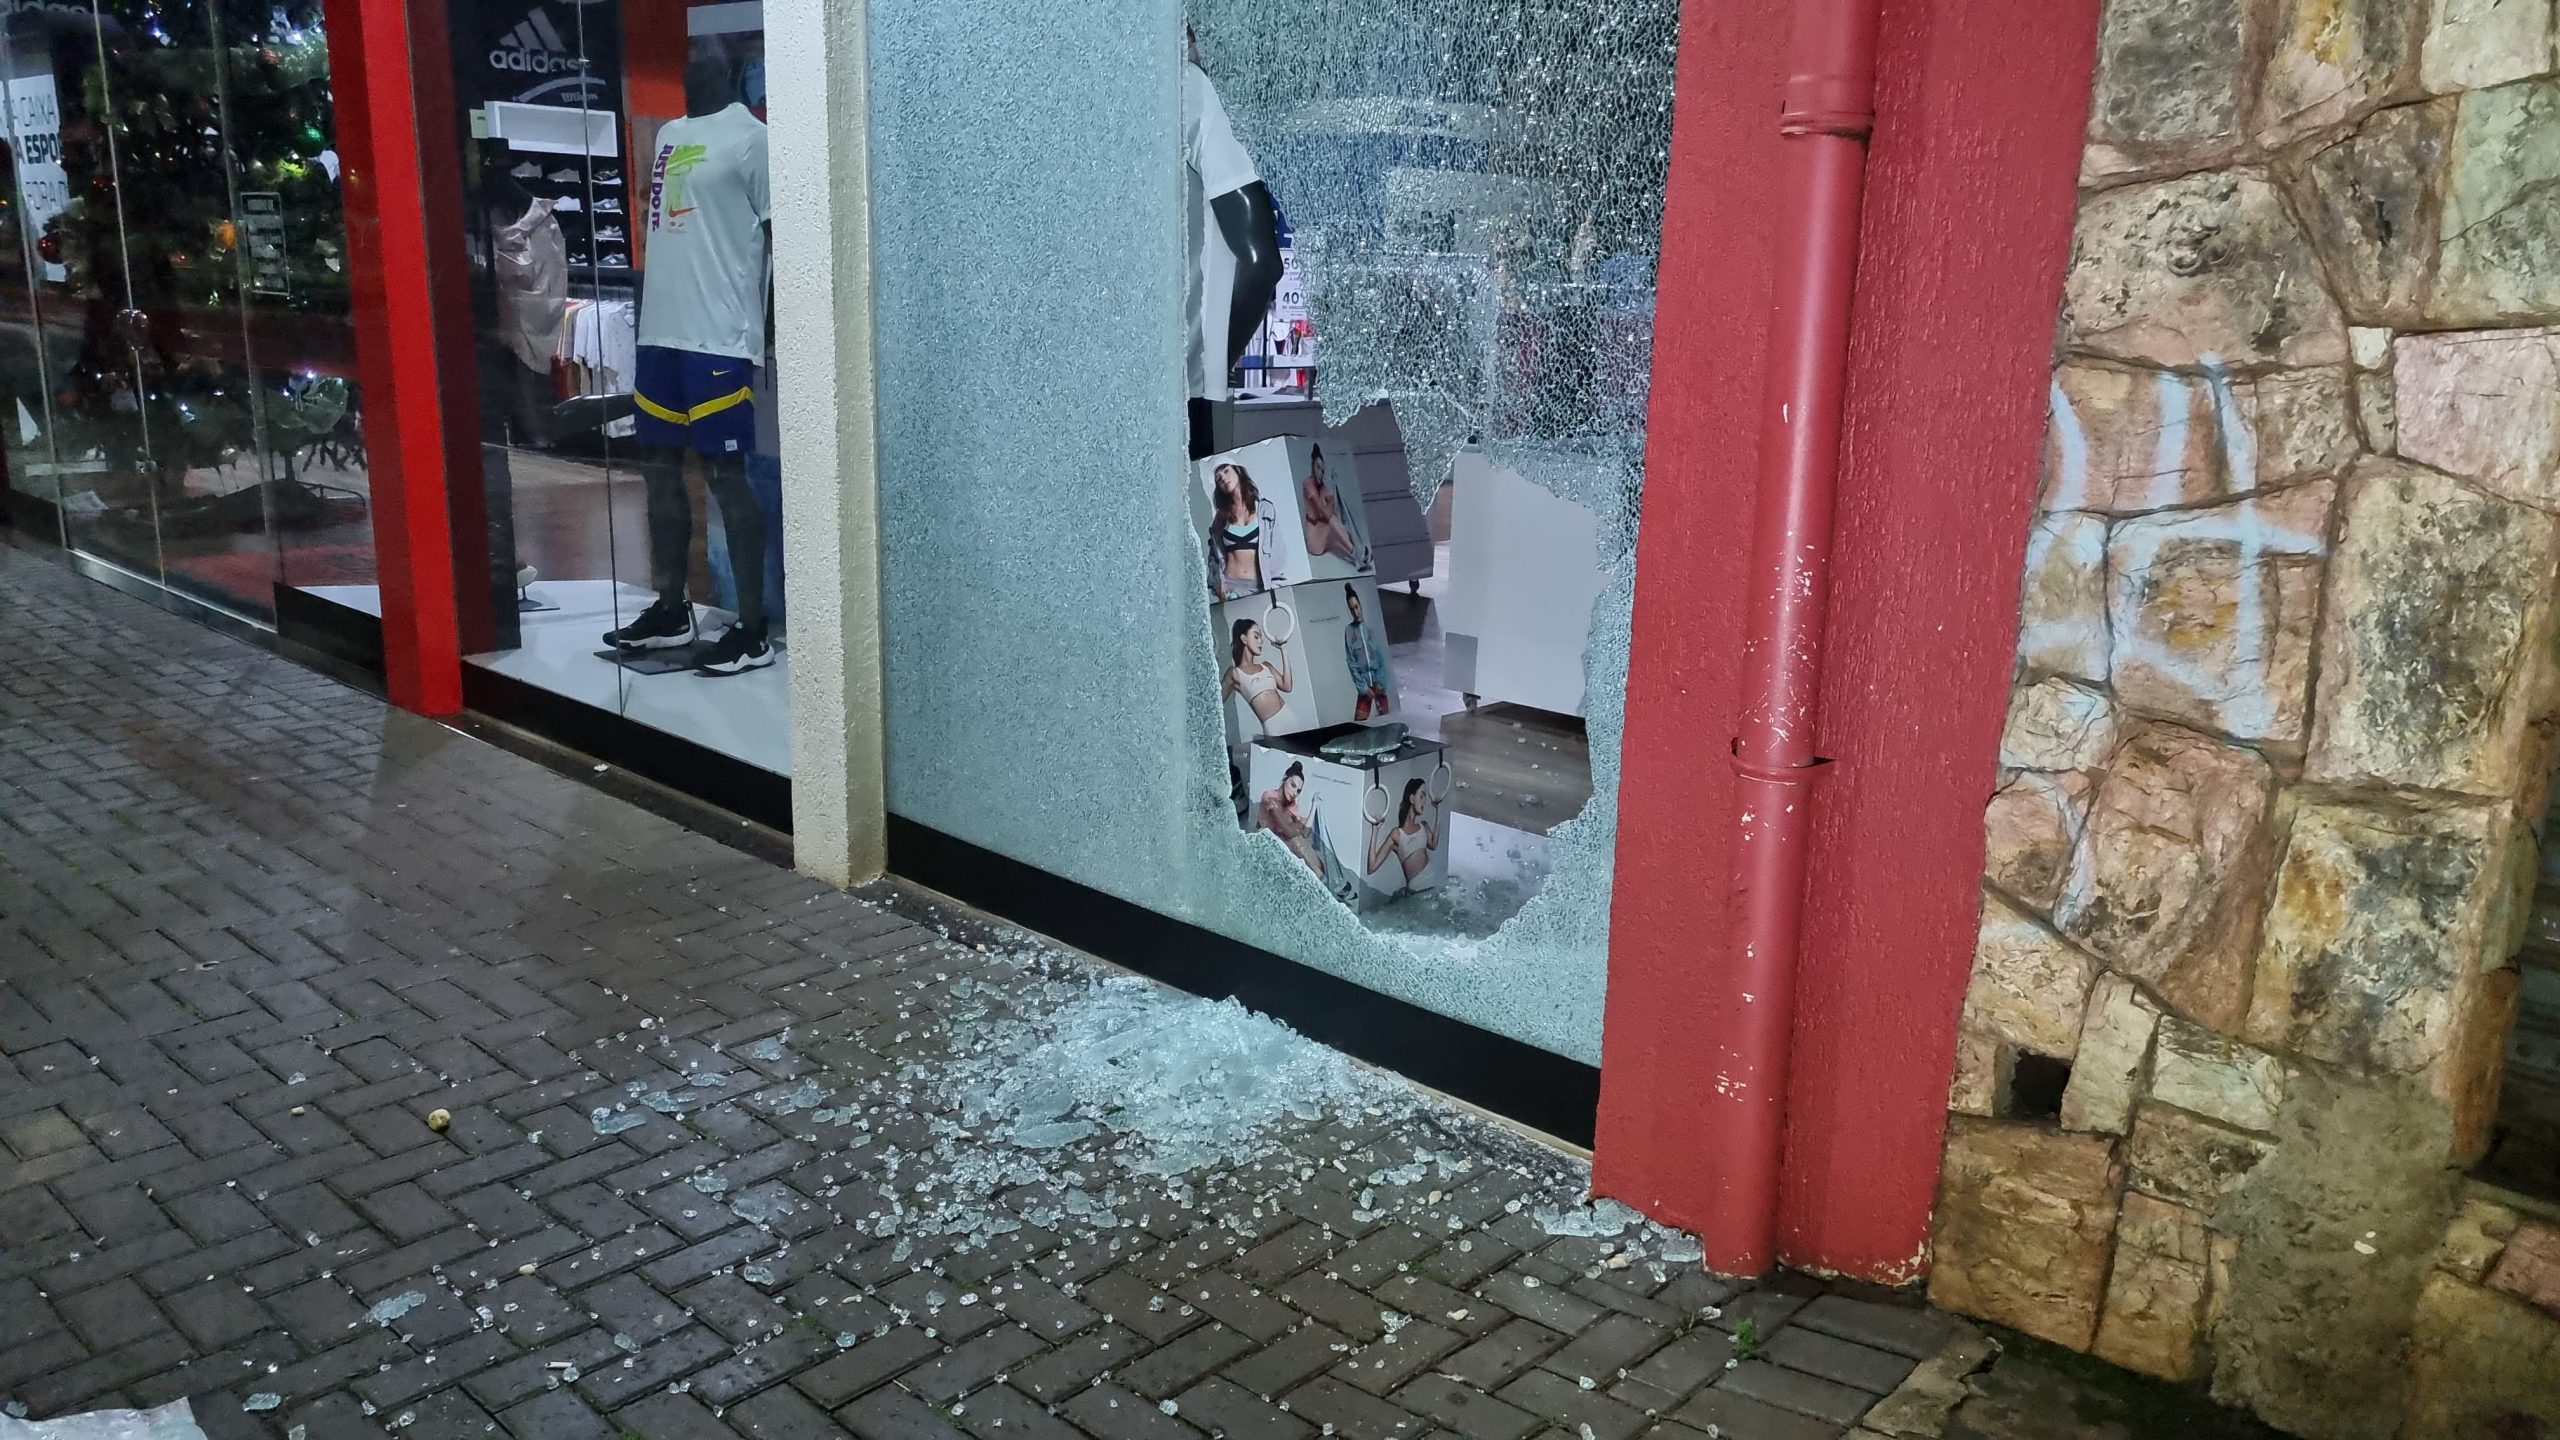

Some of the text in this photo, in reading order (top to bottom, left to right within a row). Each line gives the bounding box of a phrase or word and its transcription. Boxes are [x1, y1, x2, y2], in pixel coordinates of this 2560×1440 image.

[489, 47, 583, 74] adidas
[24, 133, 61, 165] ESPO
[652, 143, 675, 181] JUST
[650, 182, 664, 211] DO
